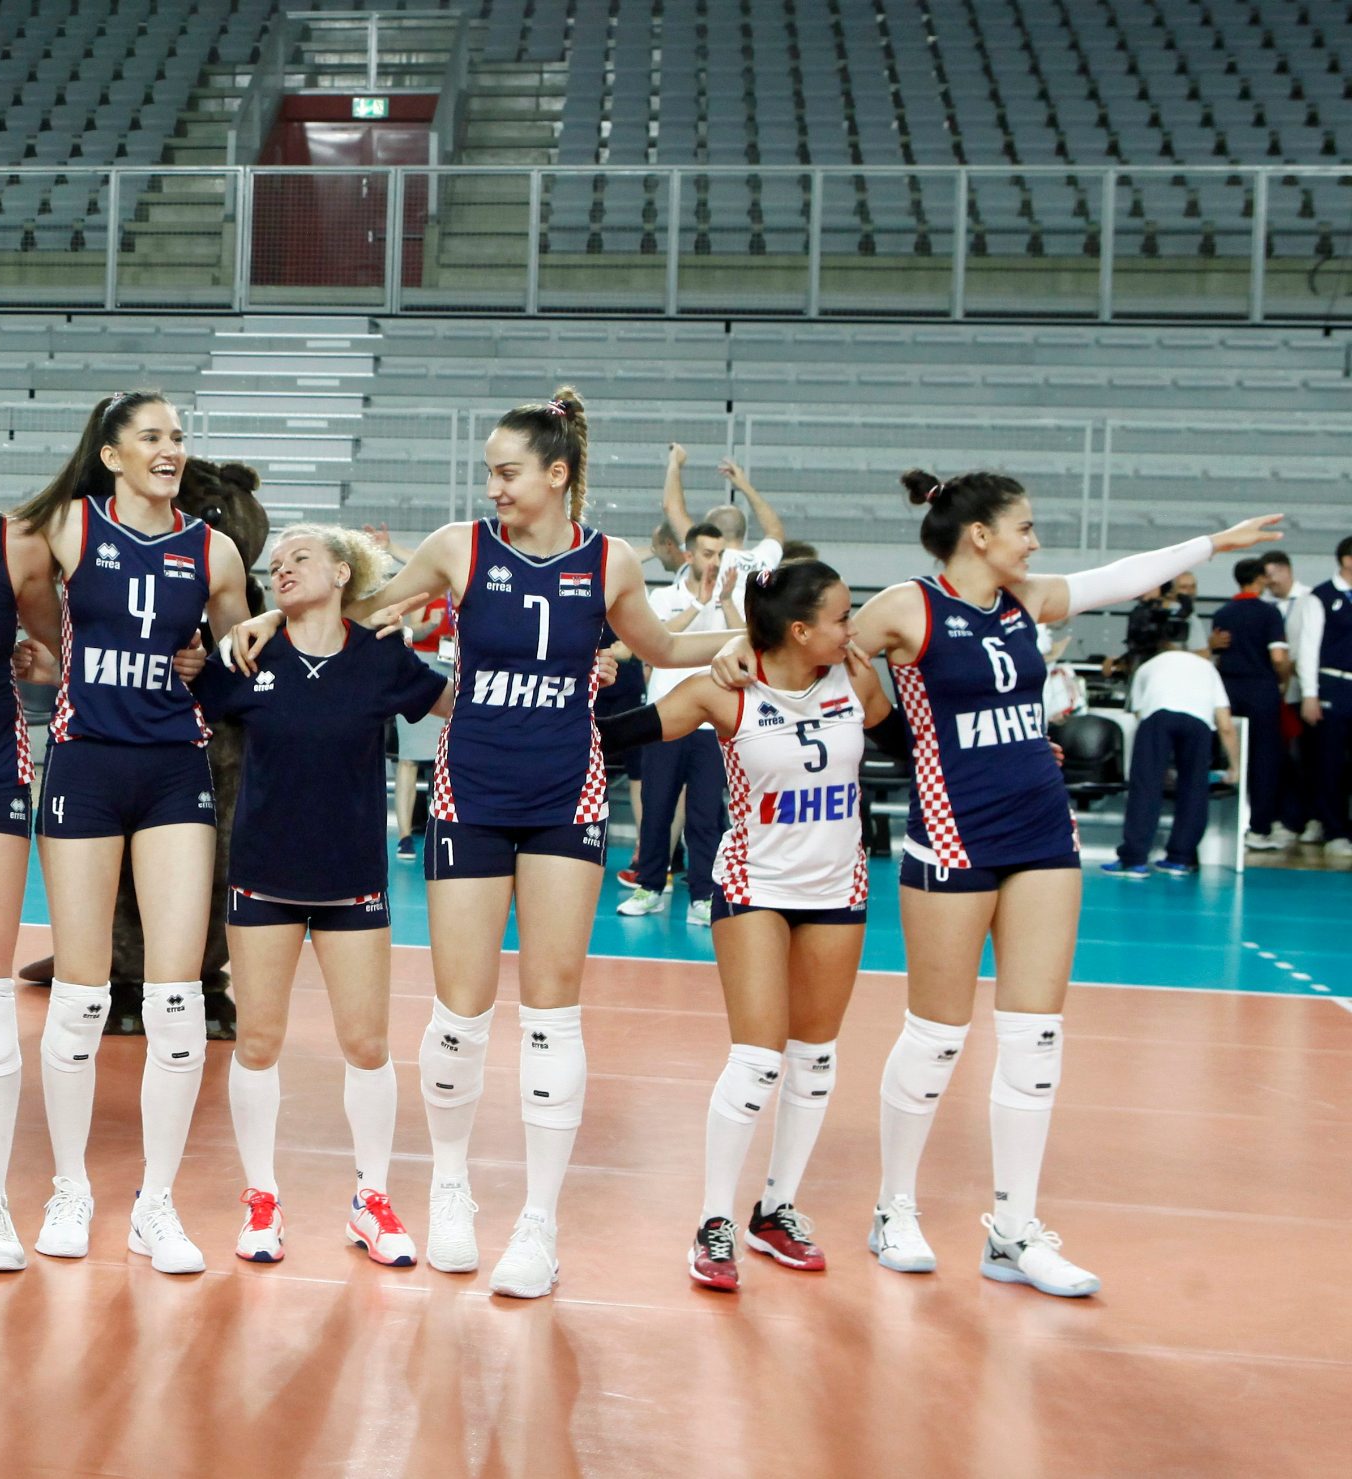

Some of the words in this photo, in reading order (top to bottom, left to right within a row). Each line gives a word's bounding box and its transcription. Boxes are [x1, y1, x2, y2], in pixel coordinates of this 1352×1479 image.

[96, 557, 121, 570] errea
[486, 581, 512, 593] errea
[128, 574, 157, 639] 4
[523, 594, 550, 661] 7
[120, 649, 174, 691] HE
[982, 636, 1018, 694] 6
[508, 673, 577, 709] HEP
[758, 716, 785, 727] errea
[796, 719, 828, 773] 5
[52, 795, 65, 823] 4
[798, 782, 857, 823] HEP
[441, 837, 454, 866] 7
